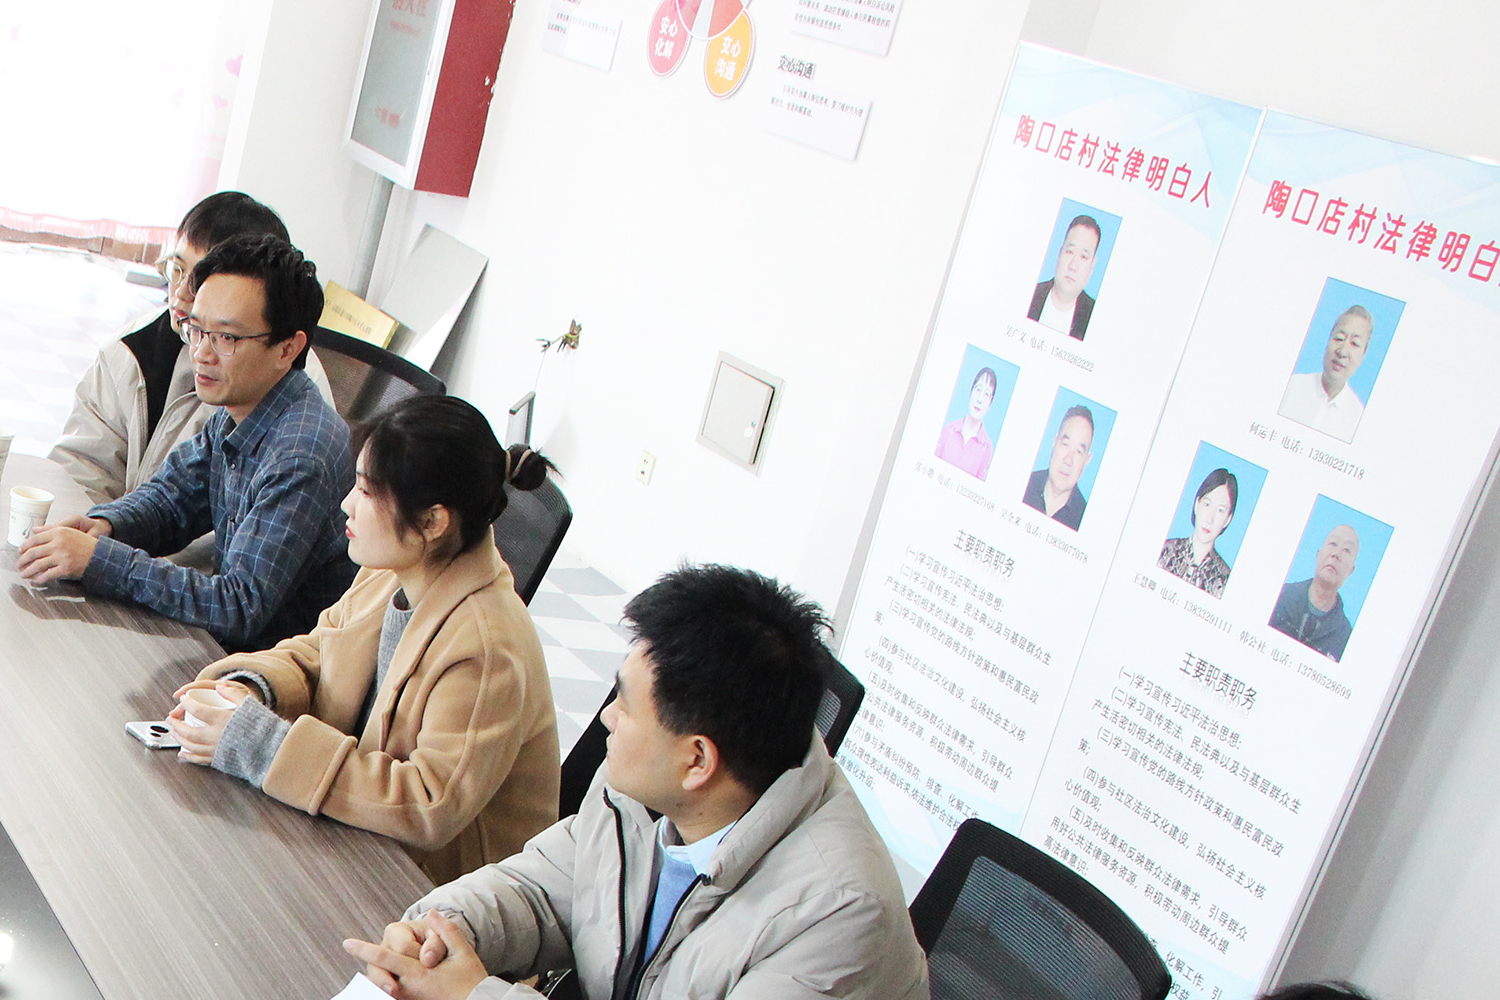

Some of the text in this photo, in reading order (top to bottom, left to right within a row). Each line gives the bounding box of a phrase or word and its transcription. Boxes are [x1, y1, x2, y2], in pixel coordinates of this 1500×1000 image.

[654, 37, 675, 60] 化解
[660, 16, 678, 37] 安心
[720, 35, 741, 58] 交心
[714, 57, 737, 81] 沟通
[778, 54, 814, 80] 交心沟通
[1013, 114, 1212, 209] 陶口店村法律明白人
[1262, 180, 1500, 288] 陶口店村法律明白
[1278, 433, 1367, 482] 电话：13930221718
[951, 527, 1018, 578] 主要职责职务
[1158, 585, 1233, 635] 电话：13833291111
[1268, 645, 1354, 701] 电话：13780528699
[1178, 648, 1259, 713] 主要职责职务
[1109, 685, 1304, 816] (二)学习宣传宪法、民法典以及与基层群众生
[1095, 724, 1285, 859] (三)学习宣传党的路线方针政策和惠民富民政
[1067, 803, 1250, 943] (五)及时收集和反映群众法律需求，引导群众
[1081, 764, 1268, 902] (四)参与社区法治文化建设，弘扬社会主义核
[1048, 813, 1231, 957] 用好公共法律服务资源，积极带动周边群众提
